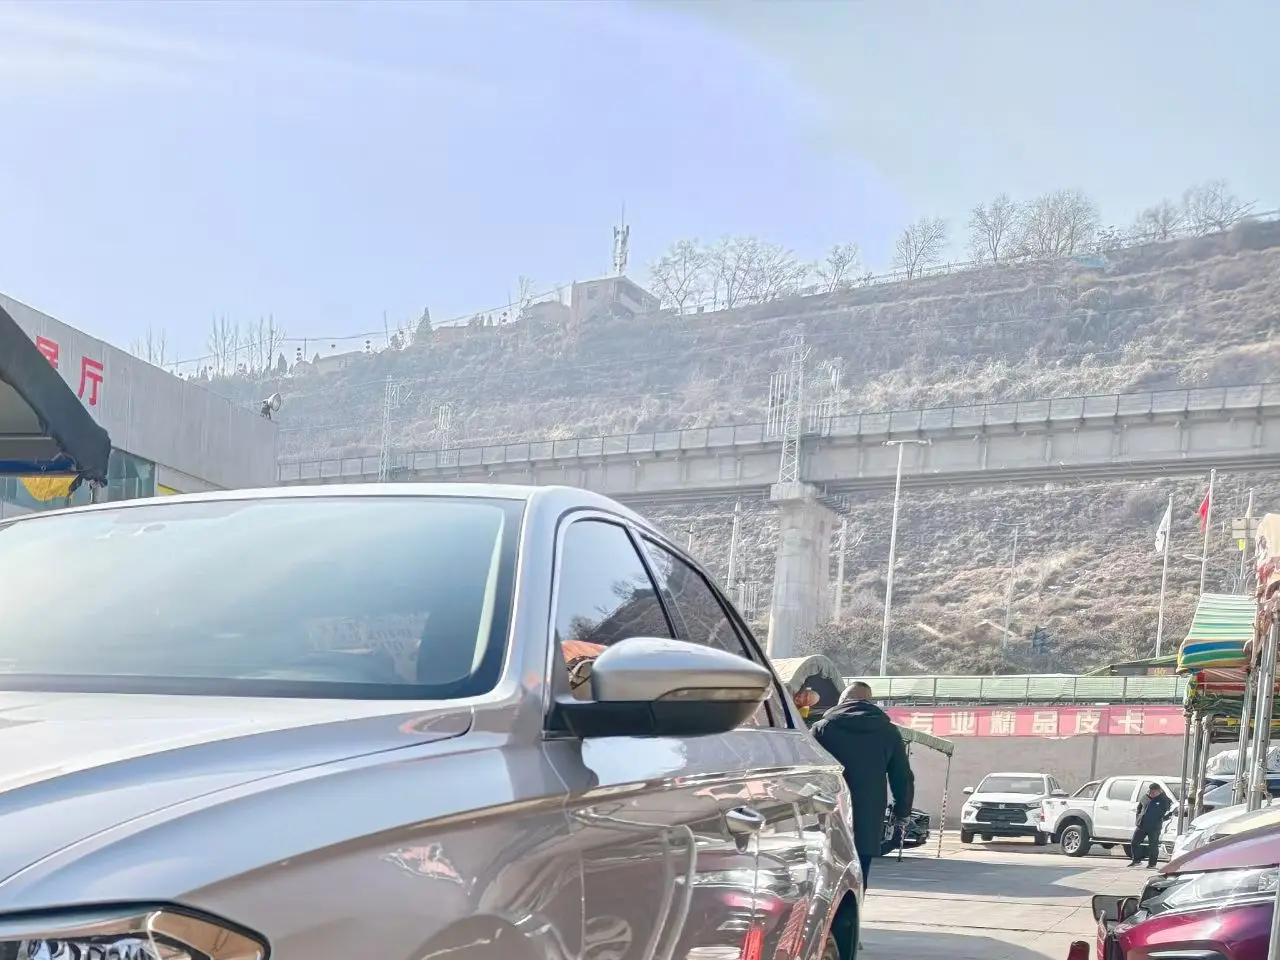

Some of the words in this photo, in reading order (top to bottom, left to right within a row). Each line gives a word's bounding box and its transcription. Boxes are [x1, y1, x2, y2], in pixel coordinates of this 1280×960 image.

[910, 711, 1144, 736] 专业精品皮卡
